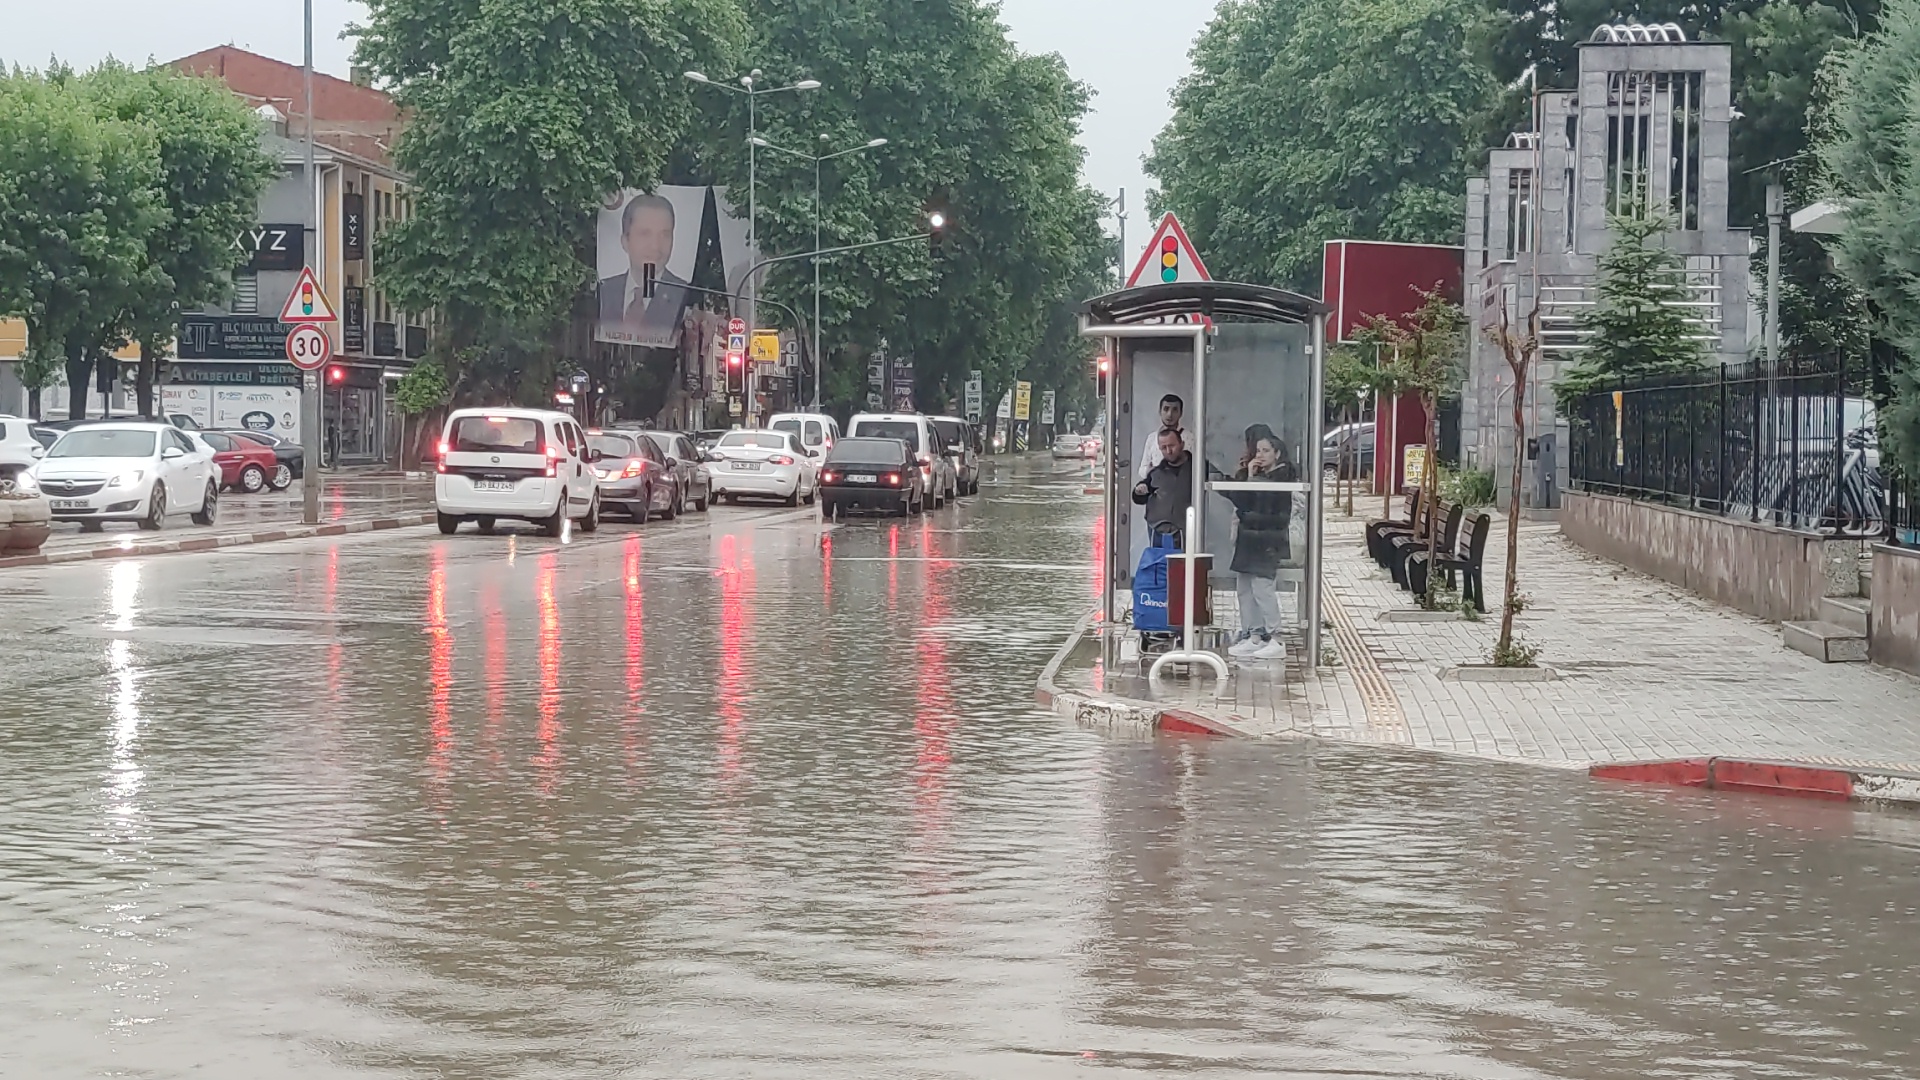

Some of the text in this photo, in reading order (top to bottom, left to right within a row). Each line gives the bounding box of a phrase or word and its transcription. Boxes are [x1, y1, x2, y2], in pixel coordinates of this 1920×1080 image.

[349, 214, 358, 246] XYZ
[730, 322, 745, 331] DUR
[295, 337, 321, 357] 30
